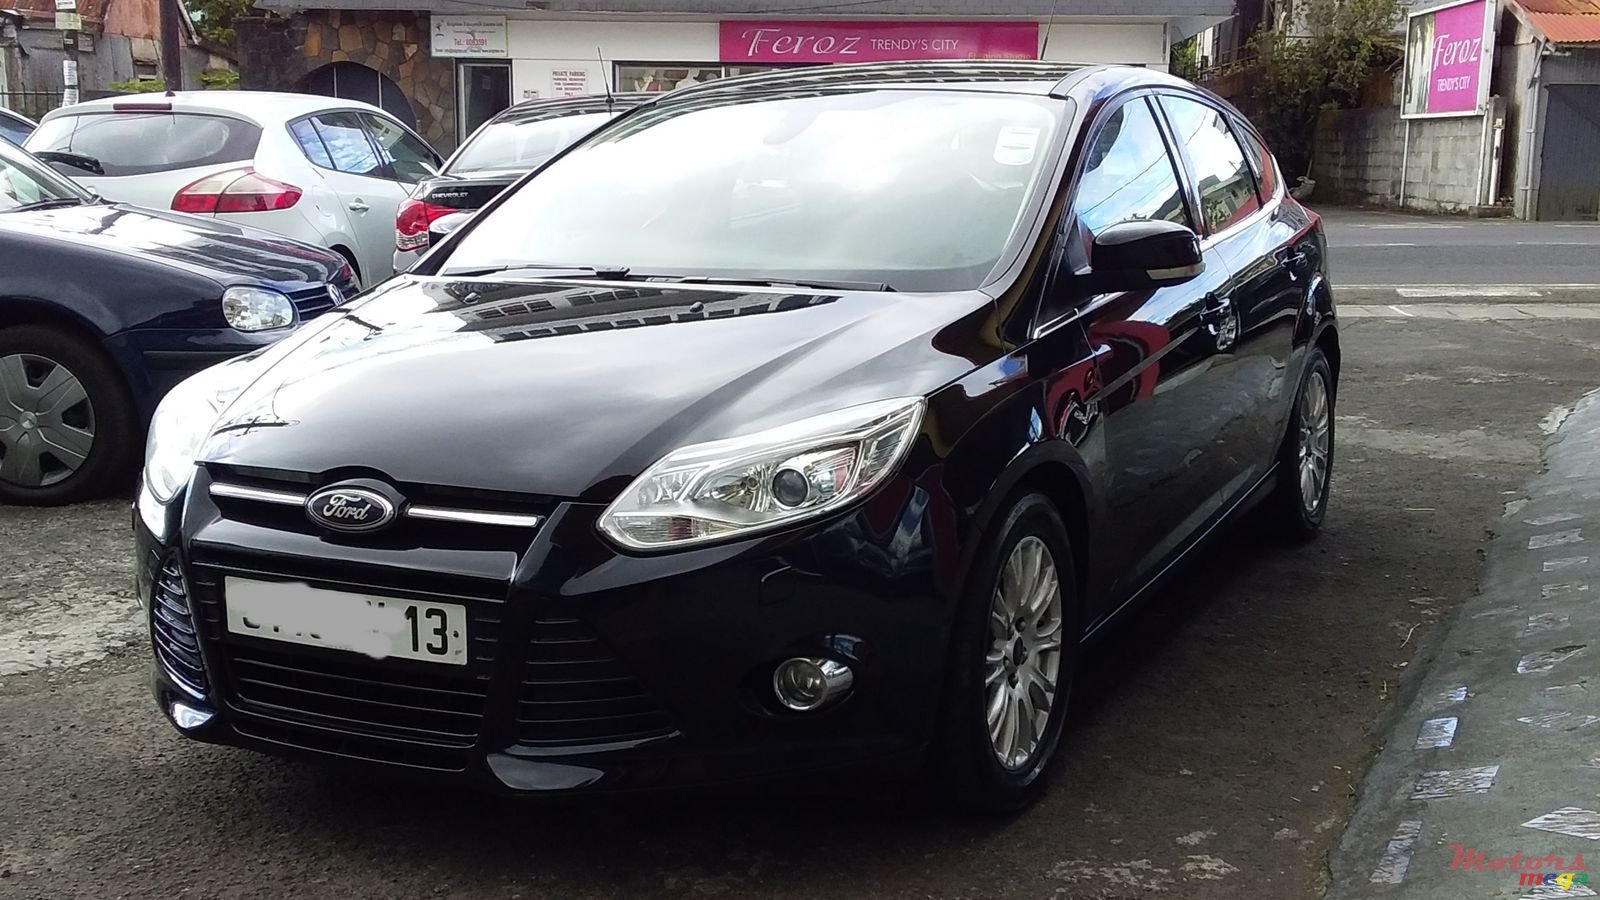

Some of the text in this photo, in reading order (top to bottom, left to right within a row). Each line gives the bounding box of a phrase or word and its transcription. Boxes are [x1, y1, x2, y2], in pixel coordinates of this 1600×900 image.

[741, 28, 959, 57] Feroz TRENDY'S CITY
[1433, 33, 1482, 72] Feroz
[1437, 75, 1471, 92] TRENDY'S CITY
[323, 494, 372, 520] Ford
[404, 605, 449, 655] 13
